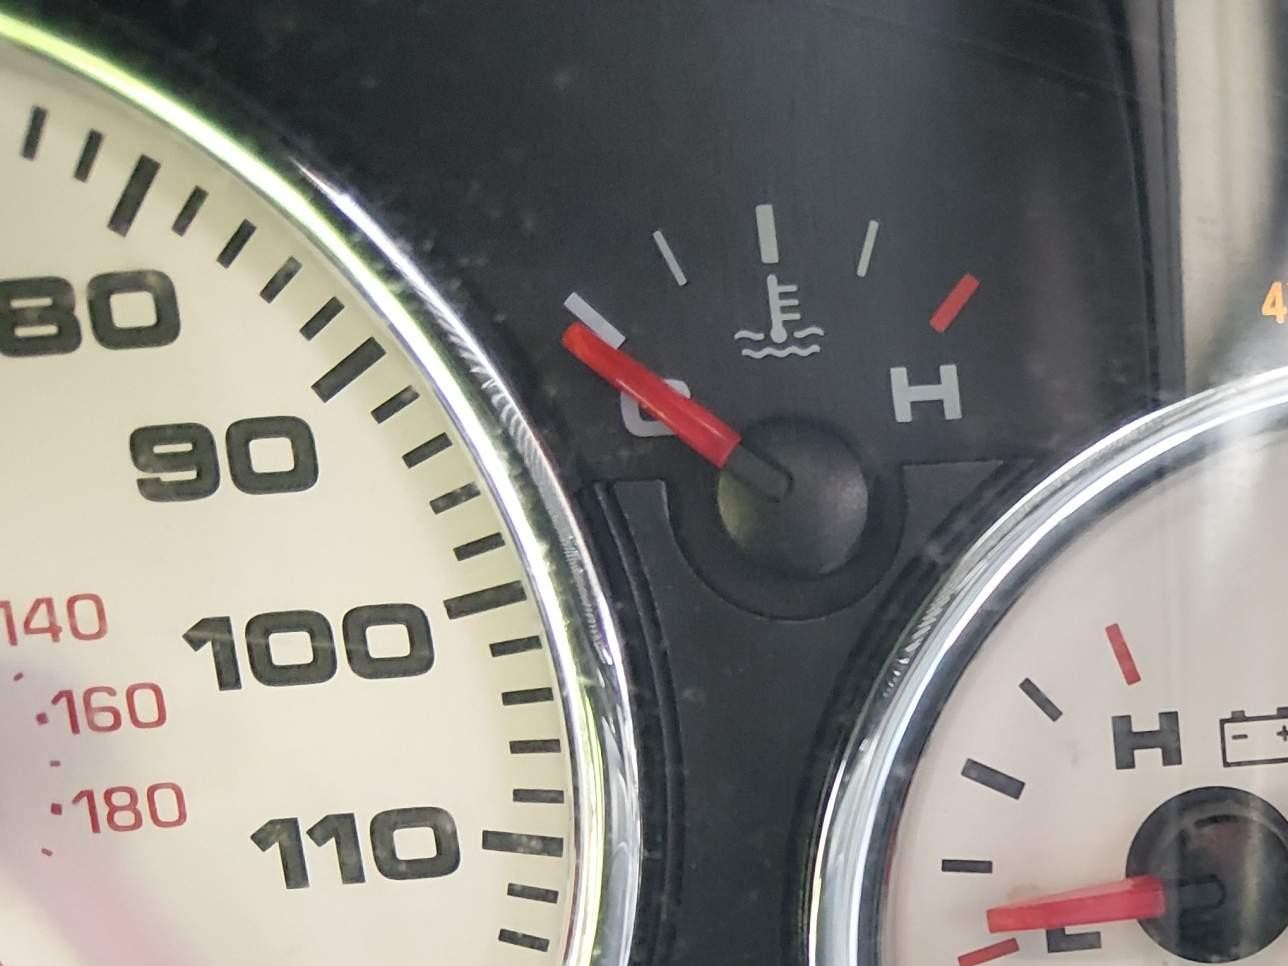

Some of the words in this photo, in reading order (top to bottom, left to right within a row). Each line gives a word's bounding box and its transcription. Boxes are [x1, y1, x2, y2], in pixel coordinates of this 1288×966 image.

[0, 269, 181, 357] 80
[890, 364, 962, 422] H
[129, 415, 319, 502] 90
[0, 593, 108, 646] 140
[182, 602, 435, 691] 100
[51, 682, 167, 735] 160
[1112, 710, 1182, 770] H
[72, 782, 187, 834] 180
[250, 806, 461, 890] 110
